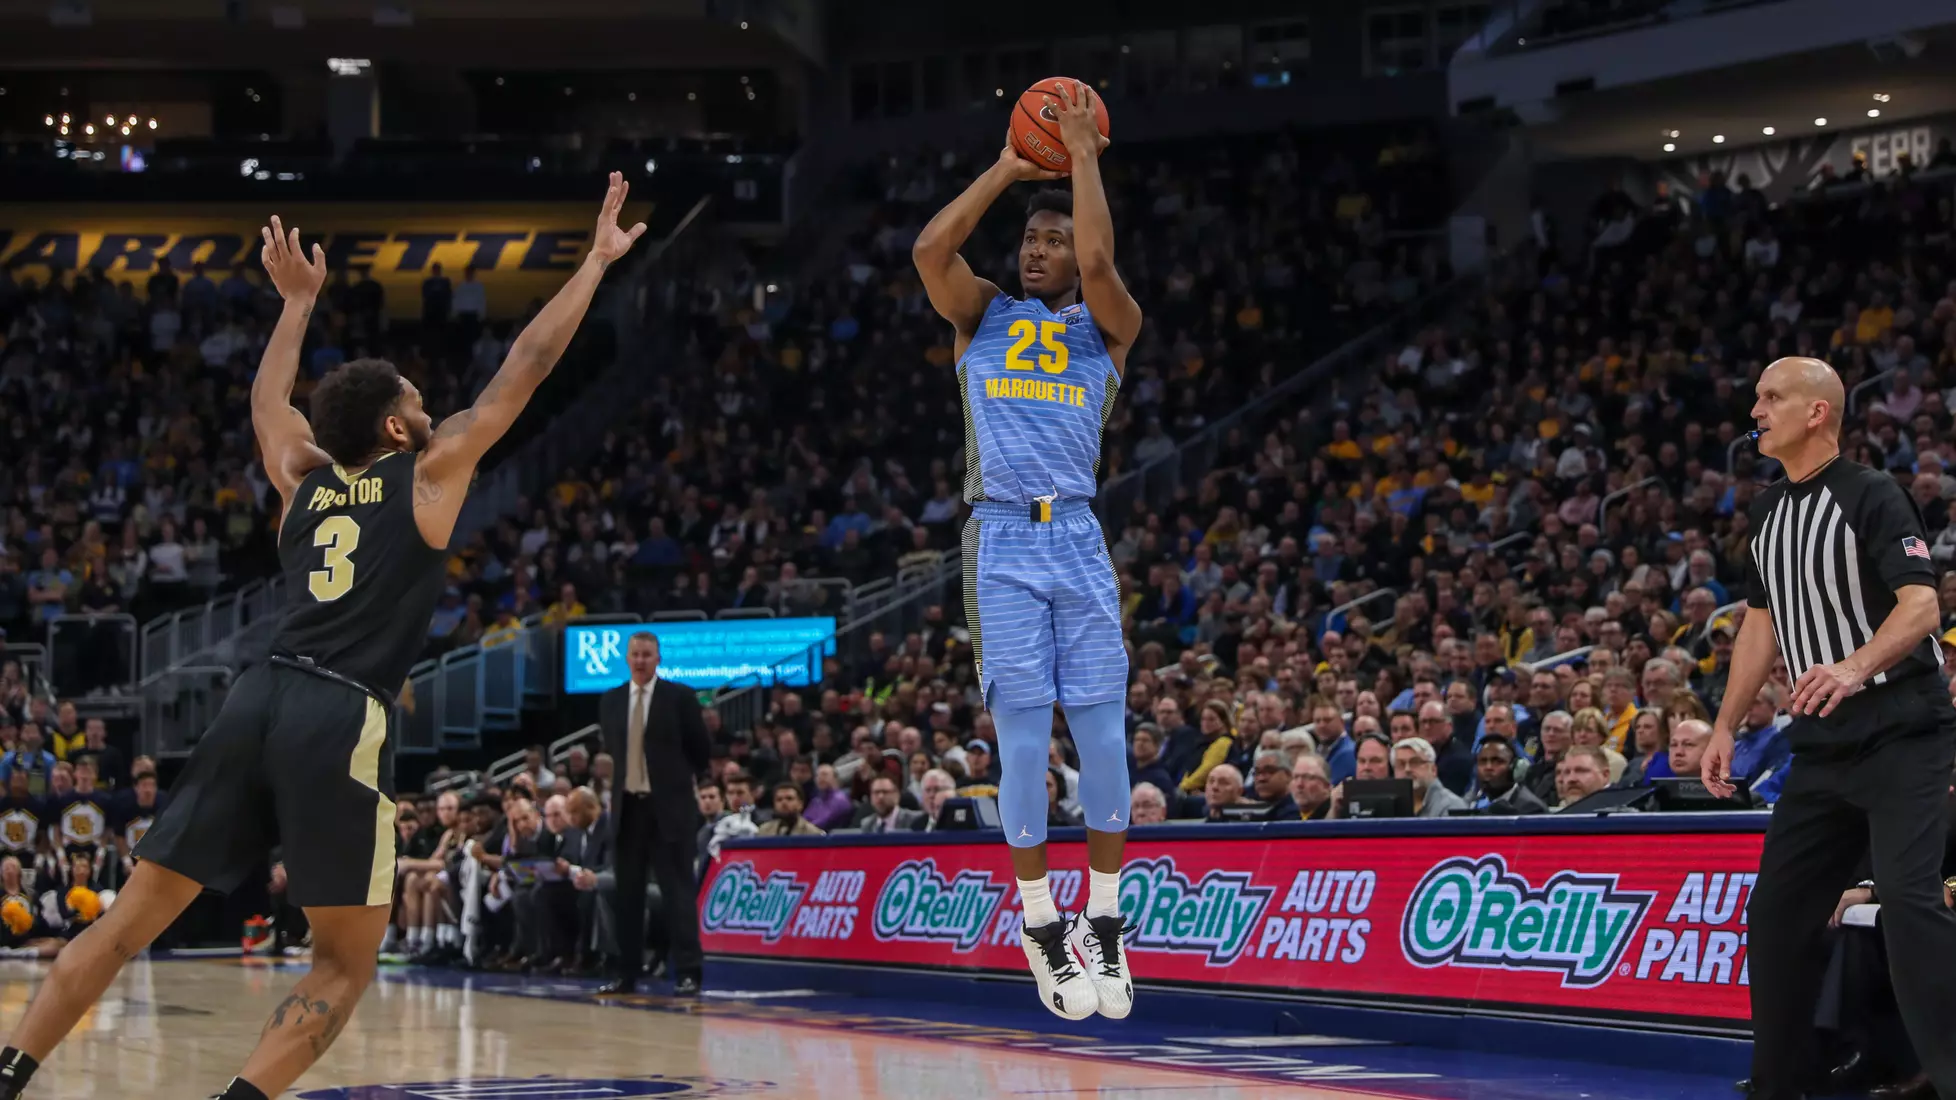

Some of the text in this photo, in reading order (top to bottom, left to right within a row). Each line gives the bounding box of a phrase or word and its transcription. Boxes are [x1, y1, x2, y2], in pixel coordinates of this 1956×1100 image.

[1024, 131, 1067, 166] ELITE
[0, 231, 590, 271] ARQETTE
[1005, 319, 1069, 374] 25
[985, 378, 1086, 407] MARQUETTE
[308, 515, 361, 602] 3
[706, 871, 797, 931] O'Reilly
[809, 870, 866, 903] AUTO
[878, 869, 994, 940] O'Reilly
[1119, 870, 1257, 951] O'Reilly
[1280, 870, 1376, 914] AUTO
[1664, 872, 1759, 925] AU
[792, 905, 859, 940] PARTS
[1256, 916, 1371, 964] PARTS
[1412, 868, 1633, 971] O'Reilly
[1635, 928, 1750, 985] PAR
